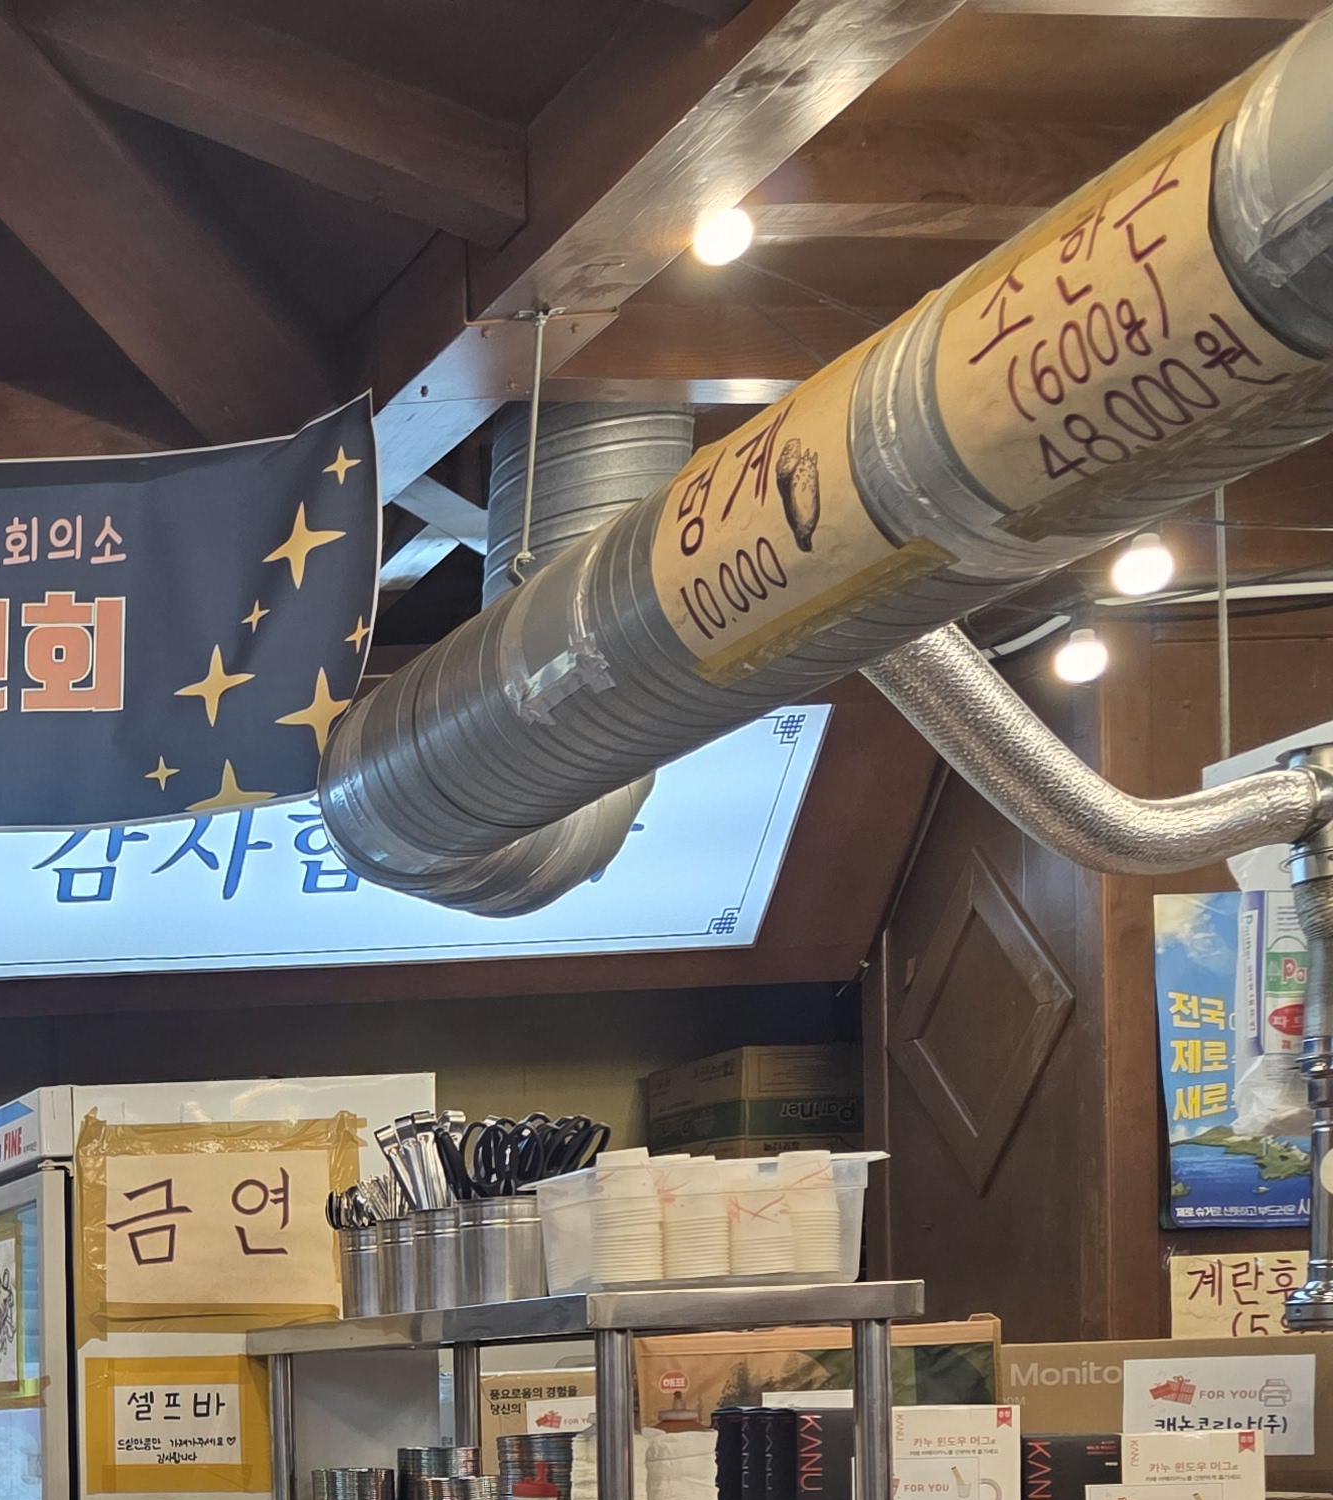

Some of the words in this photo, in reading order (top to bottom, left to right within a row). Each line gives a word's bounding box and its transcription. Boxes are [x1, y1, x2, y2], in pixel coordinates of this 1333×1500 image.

[677, 398, 796, 556] 멍게
[1167, 991, 1226, 1031] 전국
[1170, 1039, 1228, 1074] 제로
[1173, 1082, 1228, 1121] 새로
[3, 1126, 24, 1162] FINE
[107, 1165, 292, 1266] 금연
[127, 1391, 226, 1421] 셀프바
[489, 1386, 543, 1401] 풍요로움의
[546, 1385, 578, 1398] 경험을
[490, 1402, 522, 1416] 당신의
[1199, 1389, 1226, 1400] FOR
[1230, 1388, 1258, 1399] YOU
[799, 1414, 823, 1492] KANU
[913, 1437, 933, 1447] 카누
[937, 1436, 967, 1447] 윈도우
[1149, 1463, 1170, 1473] 카누
[1174, 1461, 1207, 1473] 윈도우
[904, 1483, 925, 1492] FOR
[928, 1483, 950, 1492] YOU
